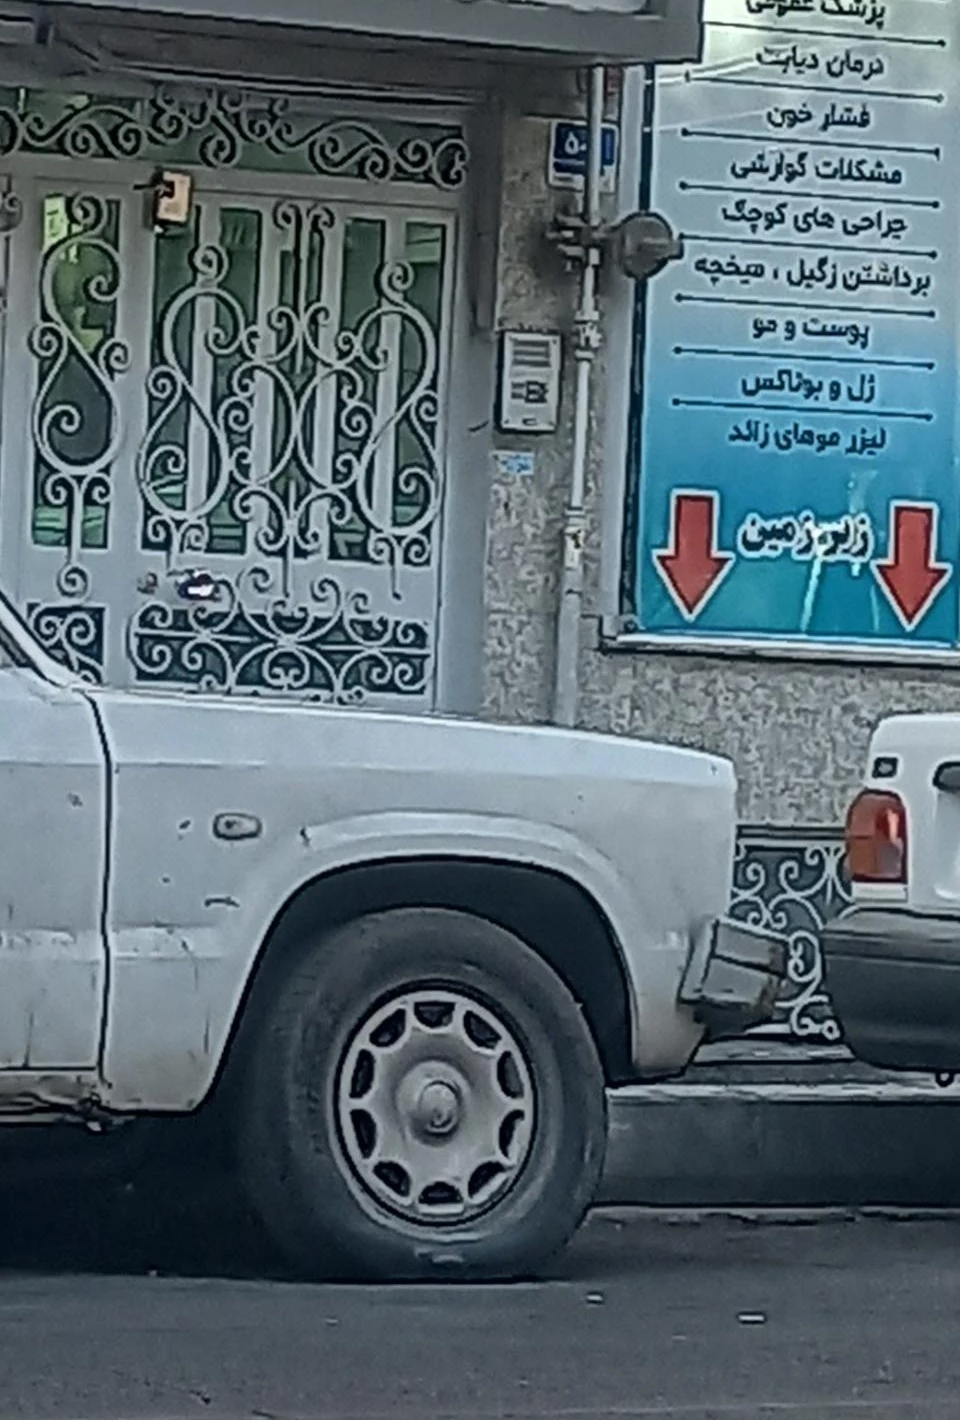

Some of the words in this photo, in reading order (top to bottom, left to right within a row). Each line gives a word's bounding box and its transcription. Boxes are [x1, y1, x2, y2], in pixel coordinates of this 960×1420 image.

[756, 45, 819, 74] دیابت
[827, 50, 884, 80] درمان
[767, 103, 813, 127] خون
[820, 103, 871, 130] فشار
[731, 152, 808, 183] گوارشی
[815, 157, 902, 185] مشکلات
[722, 200, 788, 235] کوچک
[793, 206, 834, 233] های
[842, 210, 908, 239] جراحی
[694, 255, 765, 285] میخچه
[787, 257, 837, 289] زگیل
[843, 261, 931, 297] برداشتن
[752, 318, 777, 339] مو
[784, 320, 796, 341] و
[802, 318, 869, 349] پوست
[742, 369, 823, 401] بوتاکس
[829, 382, 840, 400] و
[847, 373, 875, 403] ژل
[774, 422, 840, 453] موهای
[845, 427, 887, 455] لیزر
[741, 515, 815, 555] زمین
